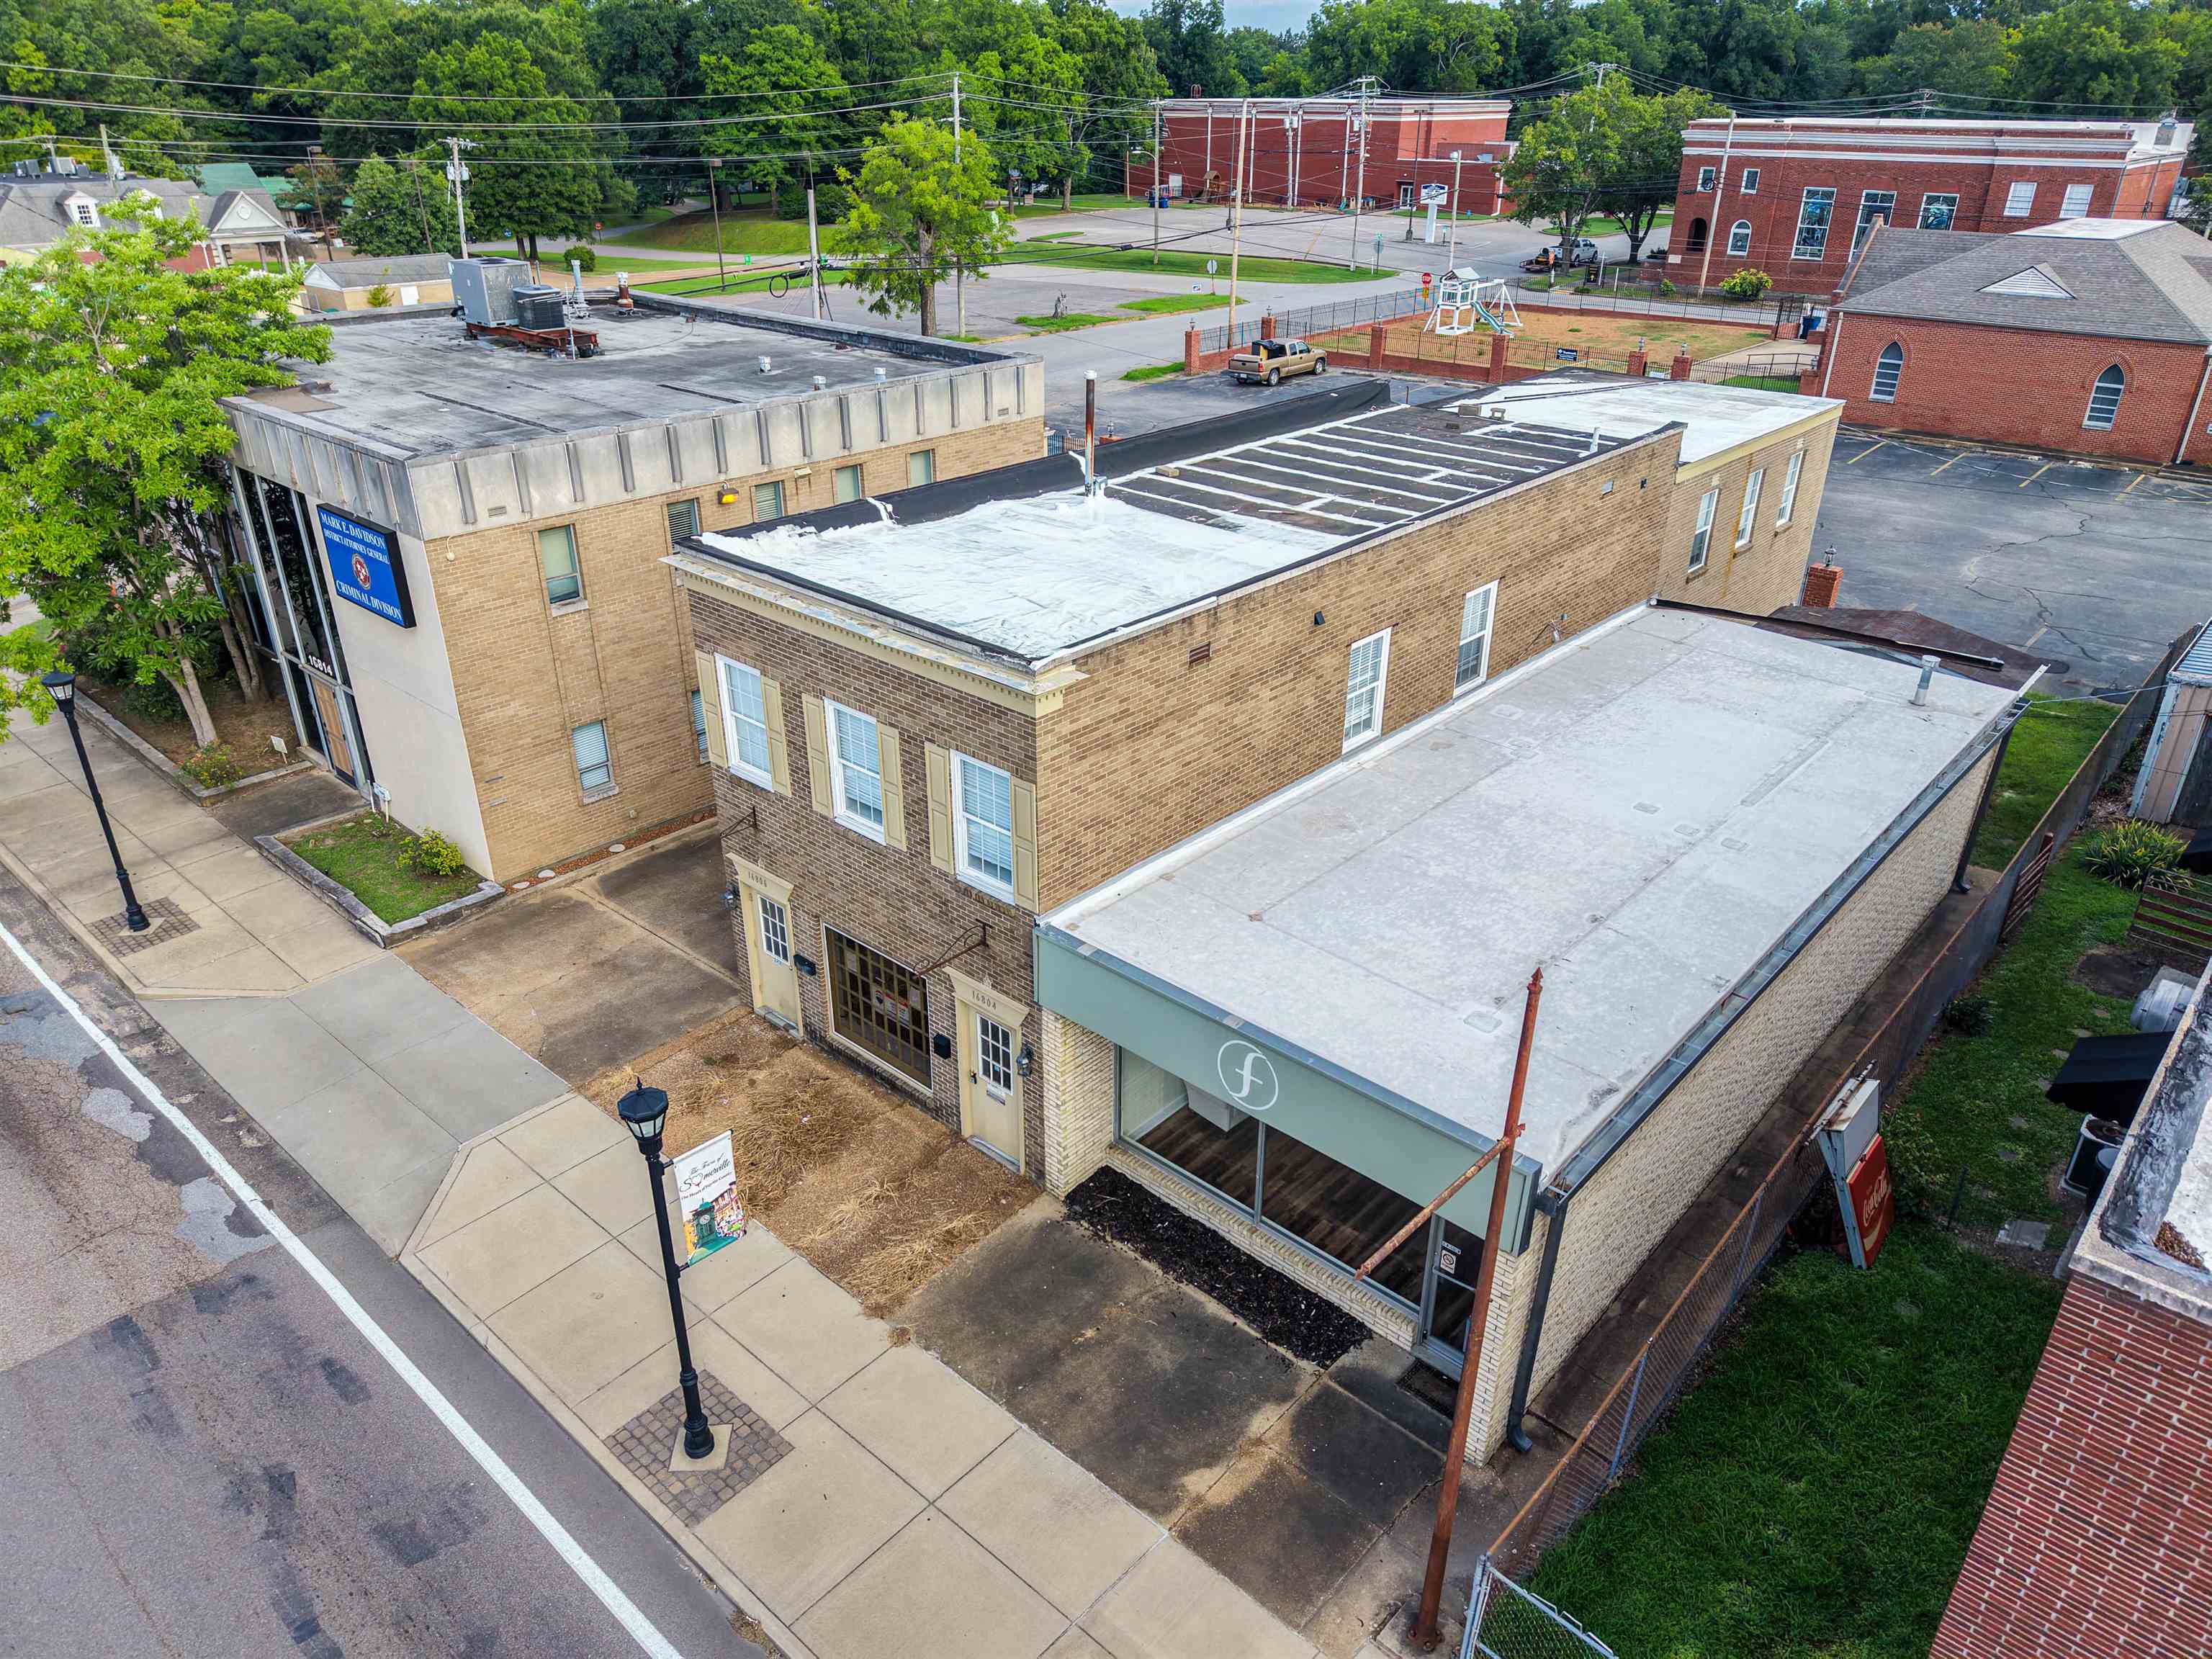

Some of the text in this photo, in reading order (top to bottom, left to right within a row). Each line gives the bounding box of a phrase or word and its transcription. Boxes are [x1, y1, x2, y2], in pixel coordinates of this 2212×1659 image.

[320, 512, 342, 531] MARK
[349, 524, 386, 549] DAVIDSON
[323, 529, 390, 565] DISTRICT ATTORNEY GENERAL
[336, 580, 403, 621] CRIMINAL DIVISION
[307, 655, 333, 676] 16814
[972, 990, 997, 1010] 16804
